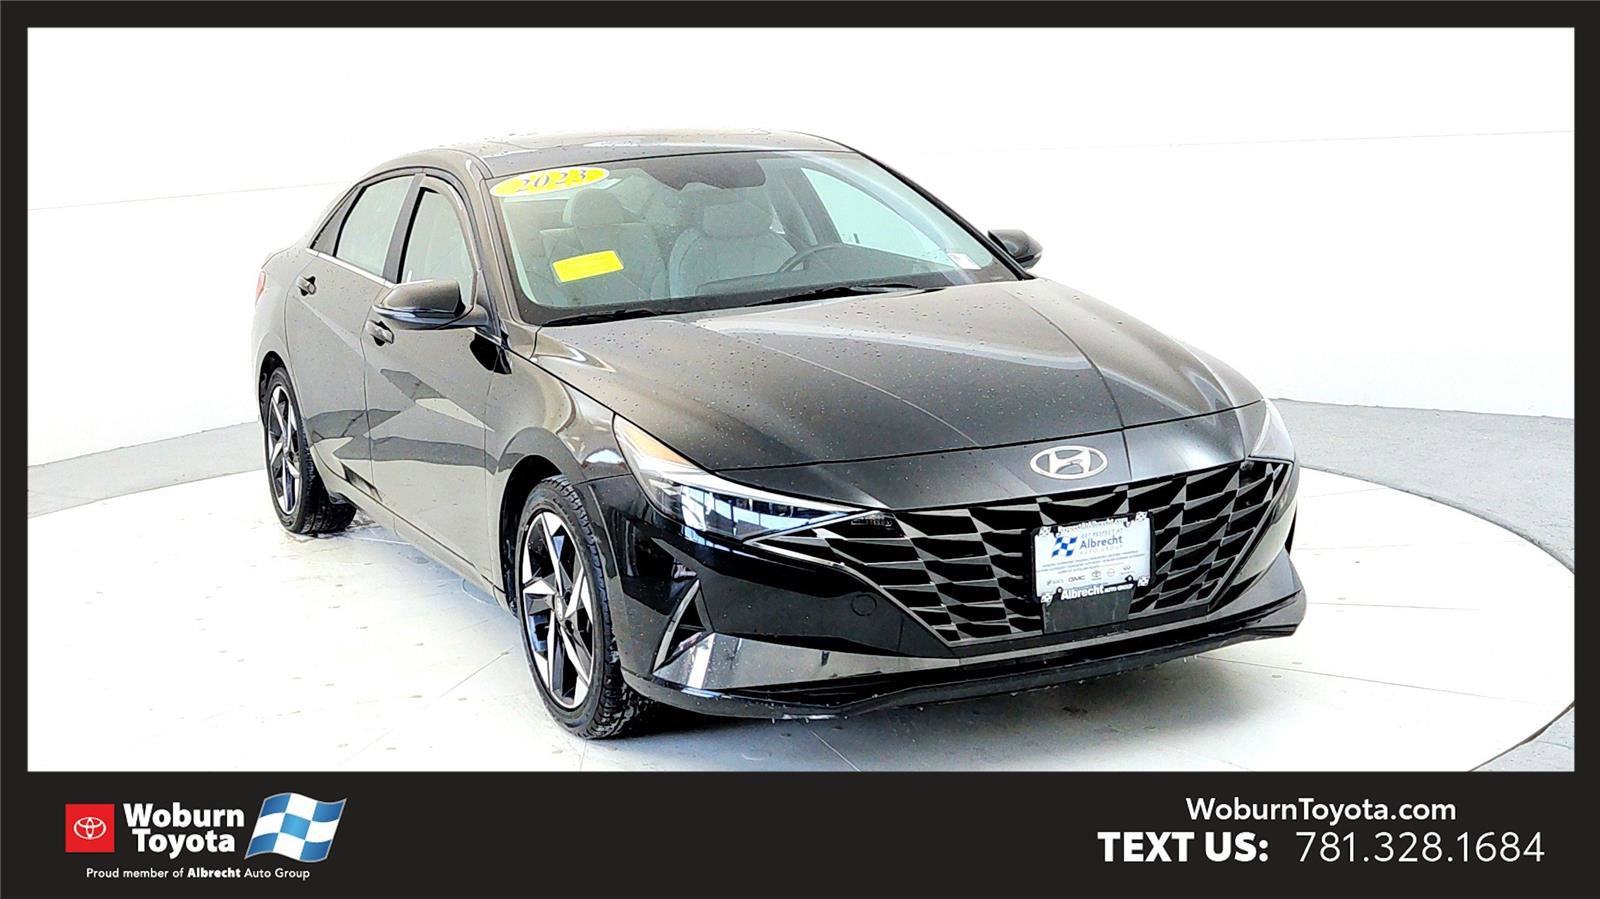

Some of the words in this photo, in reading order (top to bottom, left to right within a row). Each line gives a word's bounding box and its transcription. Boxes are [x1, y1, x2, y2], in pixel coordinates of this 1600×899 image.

[516, 169, 587, 192] 2023
[1079, 535, 1123, 549] Albrecht
[1060, 584, 1104, 600] Albrecht
